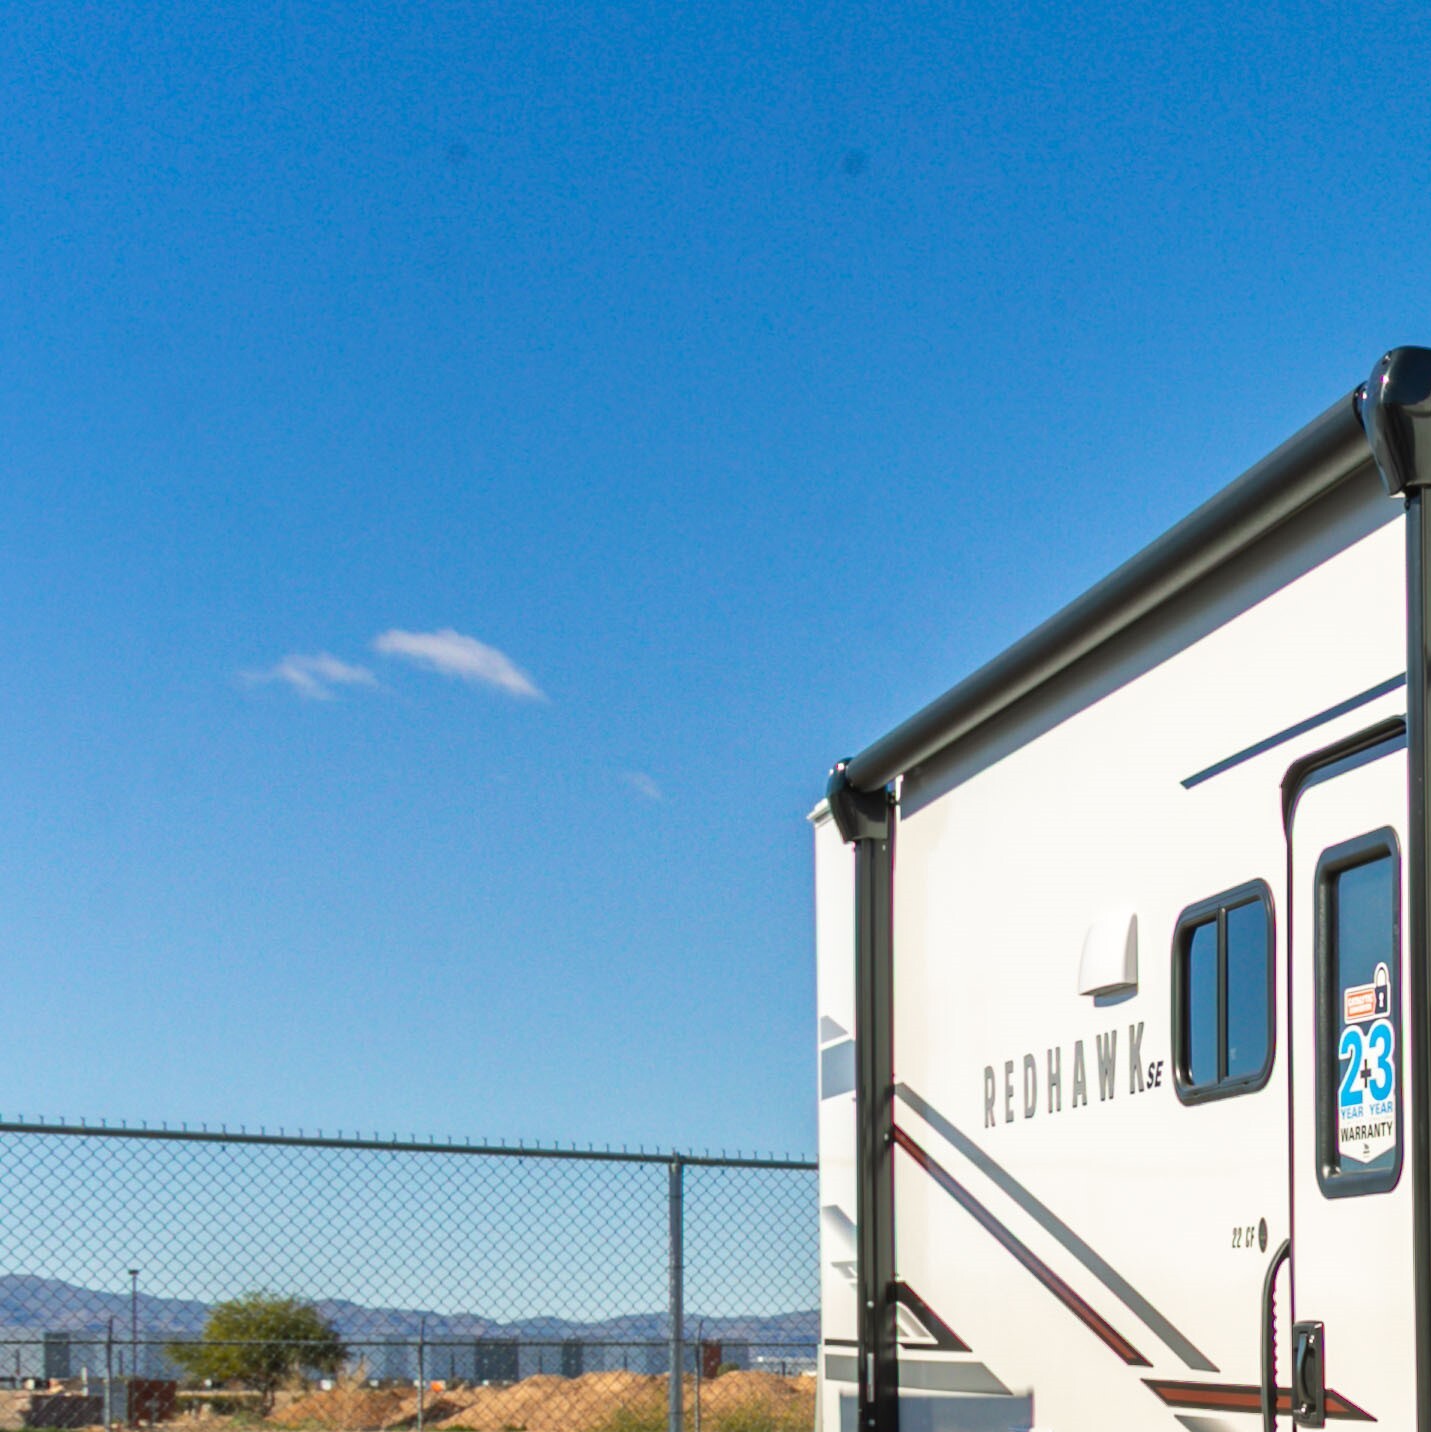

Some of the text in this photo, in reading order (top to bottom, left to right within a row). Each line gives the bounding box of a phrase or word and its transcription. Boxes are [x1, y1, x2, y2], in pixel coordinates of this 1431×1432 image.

[984, 1021, 1164, 1129] REDHAWK SE
[1341, 1101, 1393, 1120] YEAR YEAR
[1340, 1121, 1393, 1142] WARRANTY
